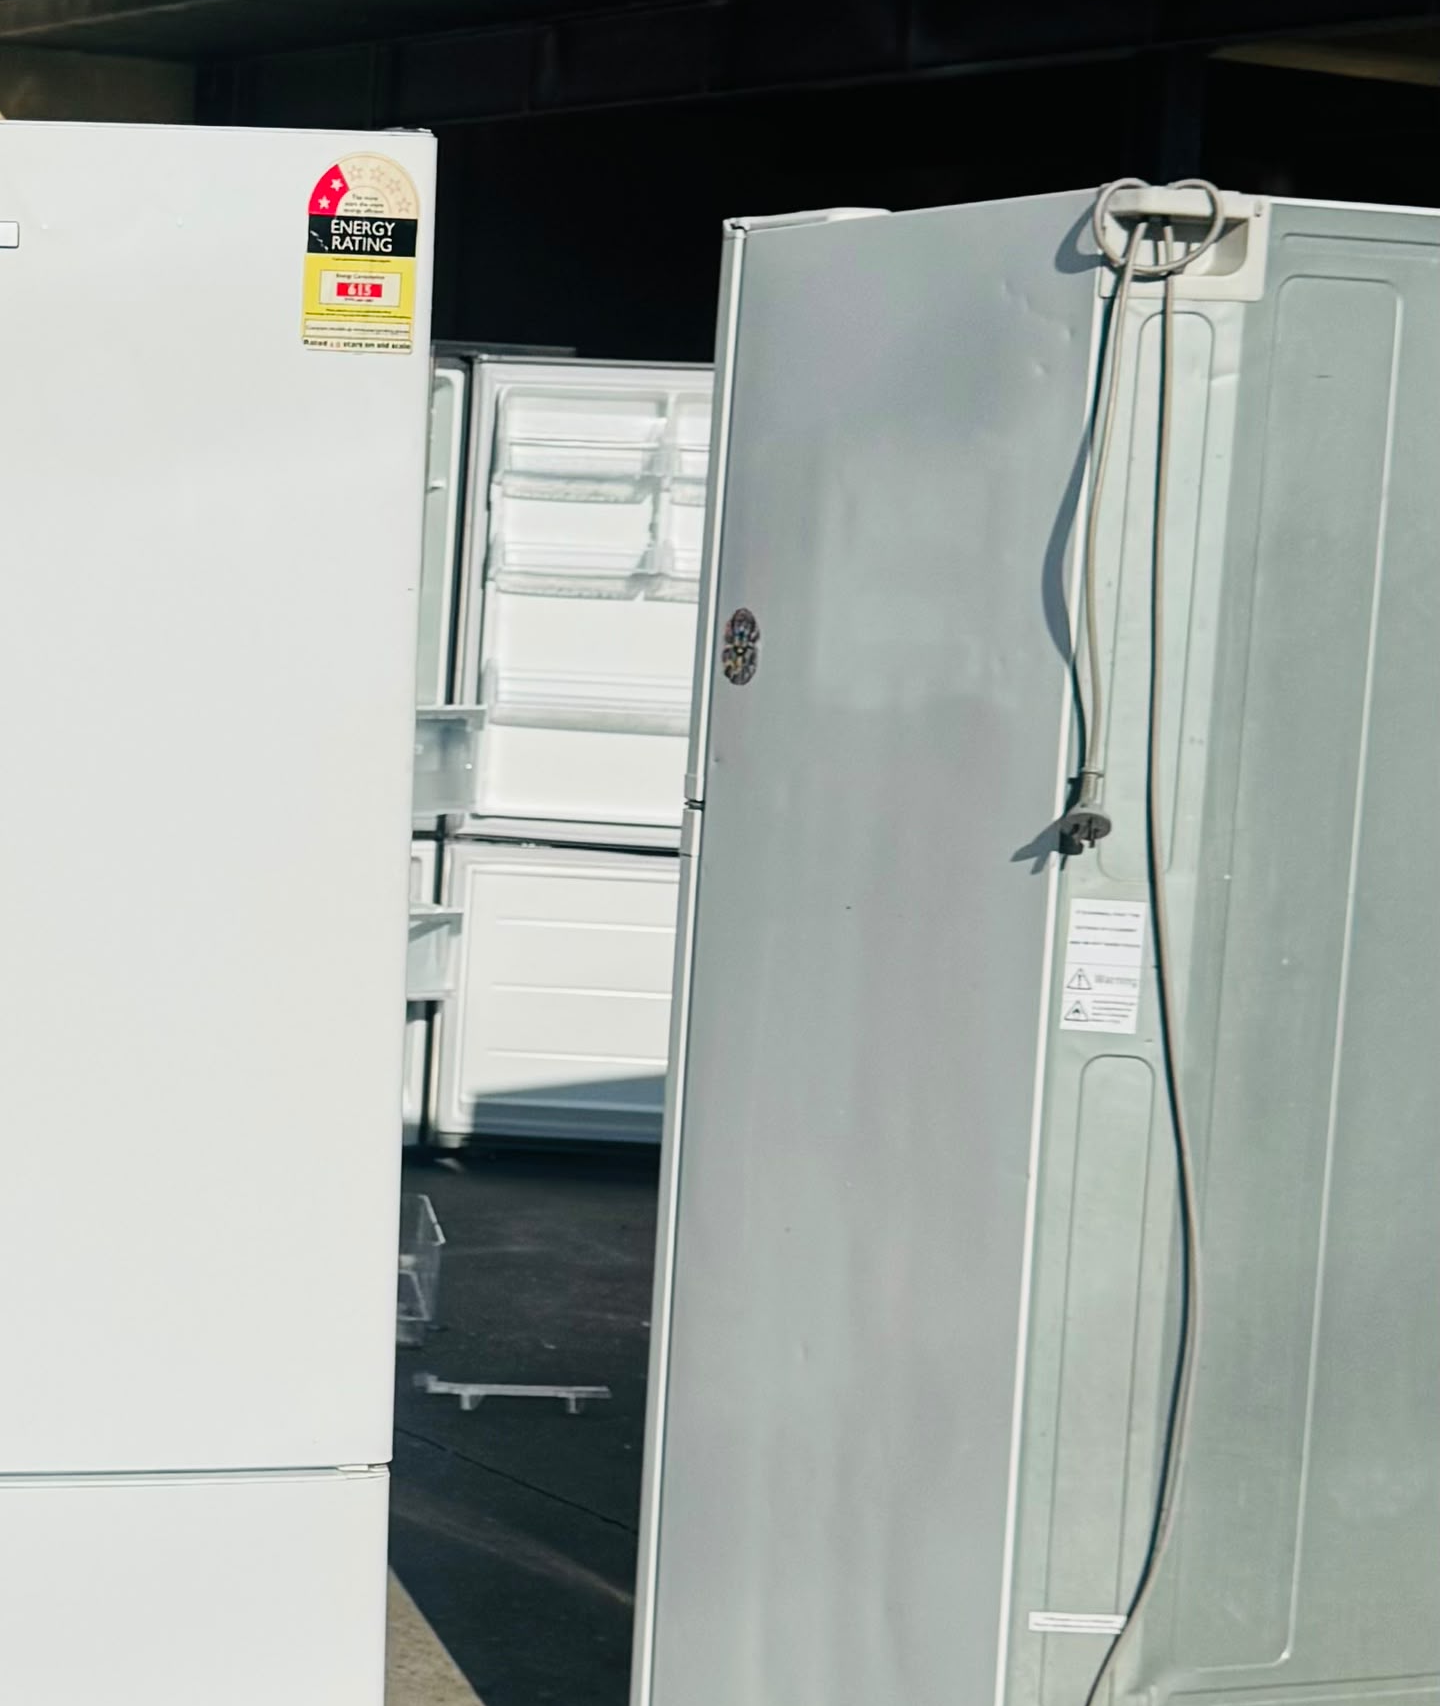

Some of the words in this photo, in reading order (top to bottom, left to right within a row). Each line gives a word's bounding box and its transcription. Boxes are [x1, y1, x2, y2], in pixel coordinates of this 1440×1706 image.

[330, 219, 396, 237] ENERGY
[331, 236, 393, 253] RATING
[347, 283, 372, 296] 615
